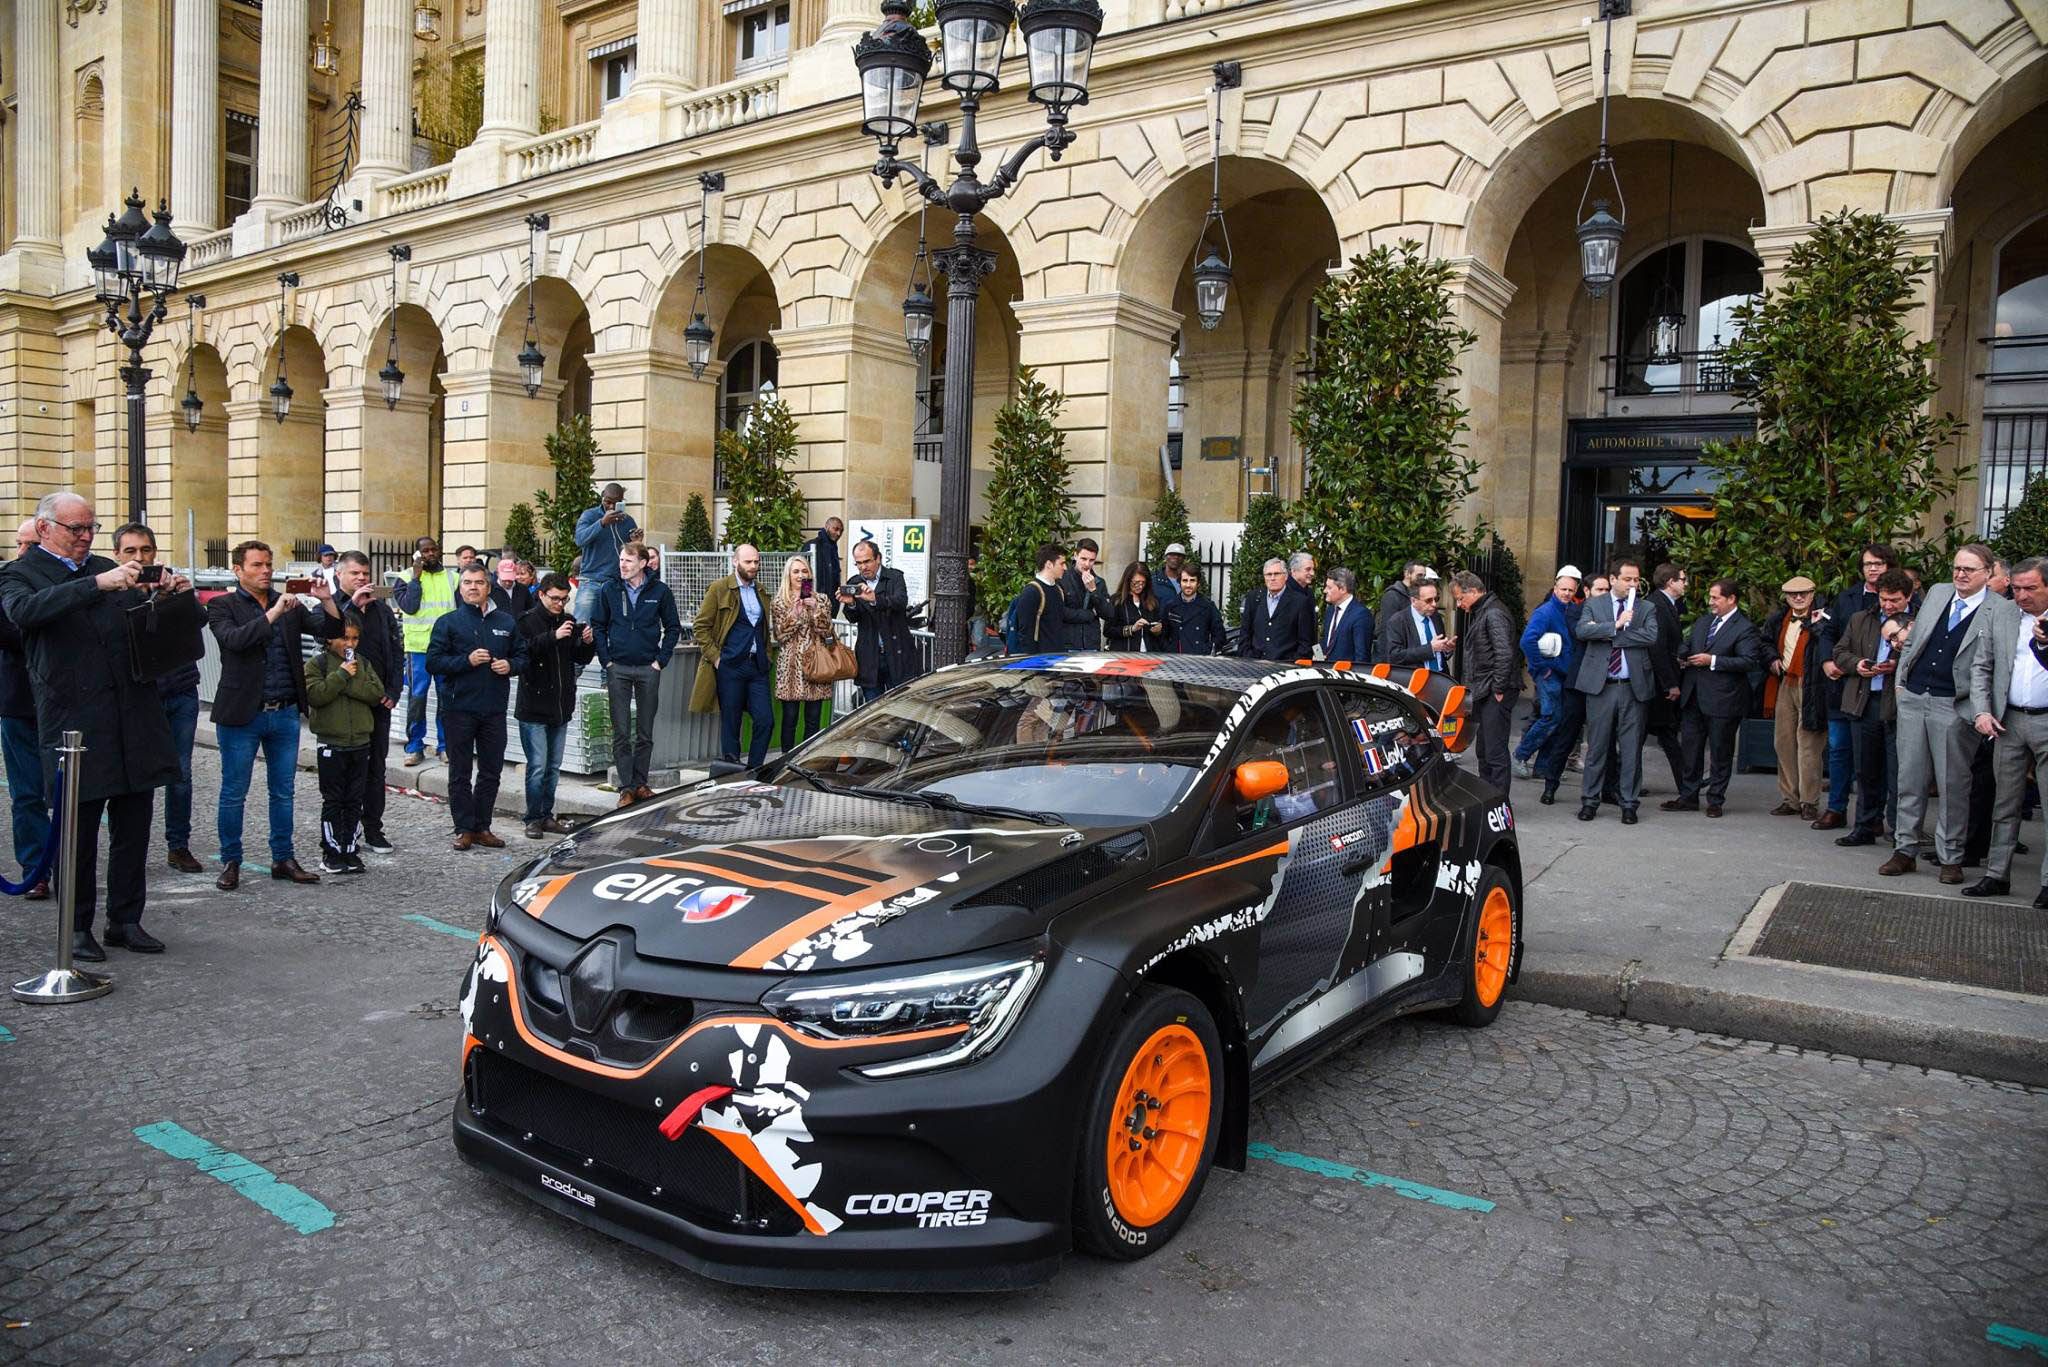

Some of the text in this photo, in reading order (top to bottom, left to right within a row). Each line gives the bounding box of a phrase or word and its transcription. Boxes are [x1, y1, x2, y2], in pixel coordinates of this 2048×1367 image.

[1587, 436, 1665, 449] AUTOMOBILE
[884, 526, 893, 569] evalier
[592, 872, 704, 905] elf
[541, 1174, 596, 1207] prodrive
[845, 1189, 992, 1215] COOPER
[916, 1209, 989, 1229] TIRES
[1103, 1187, 1147, 1245] COOPER
